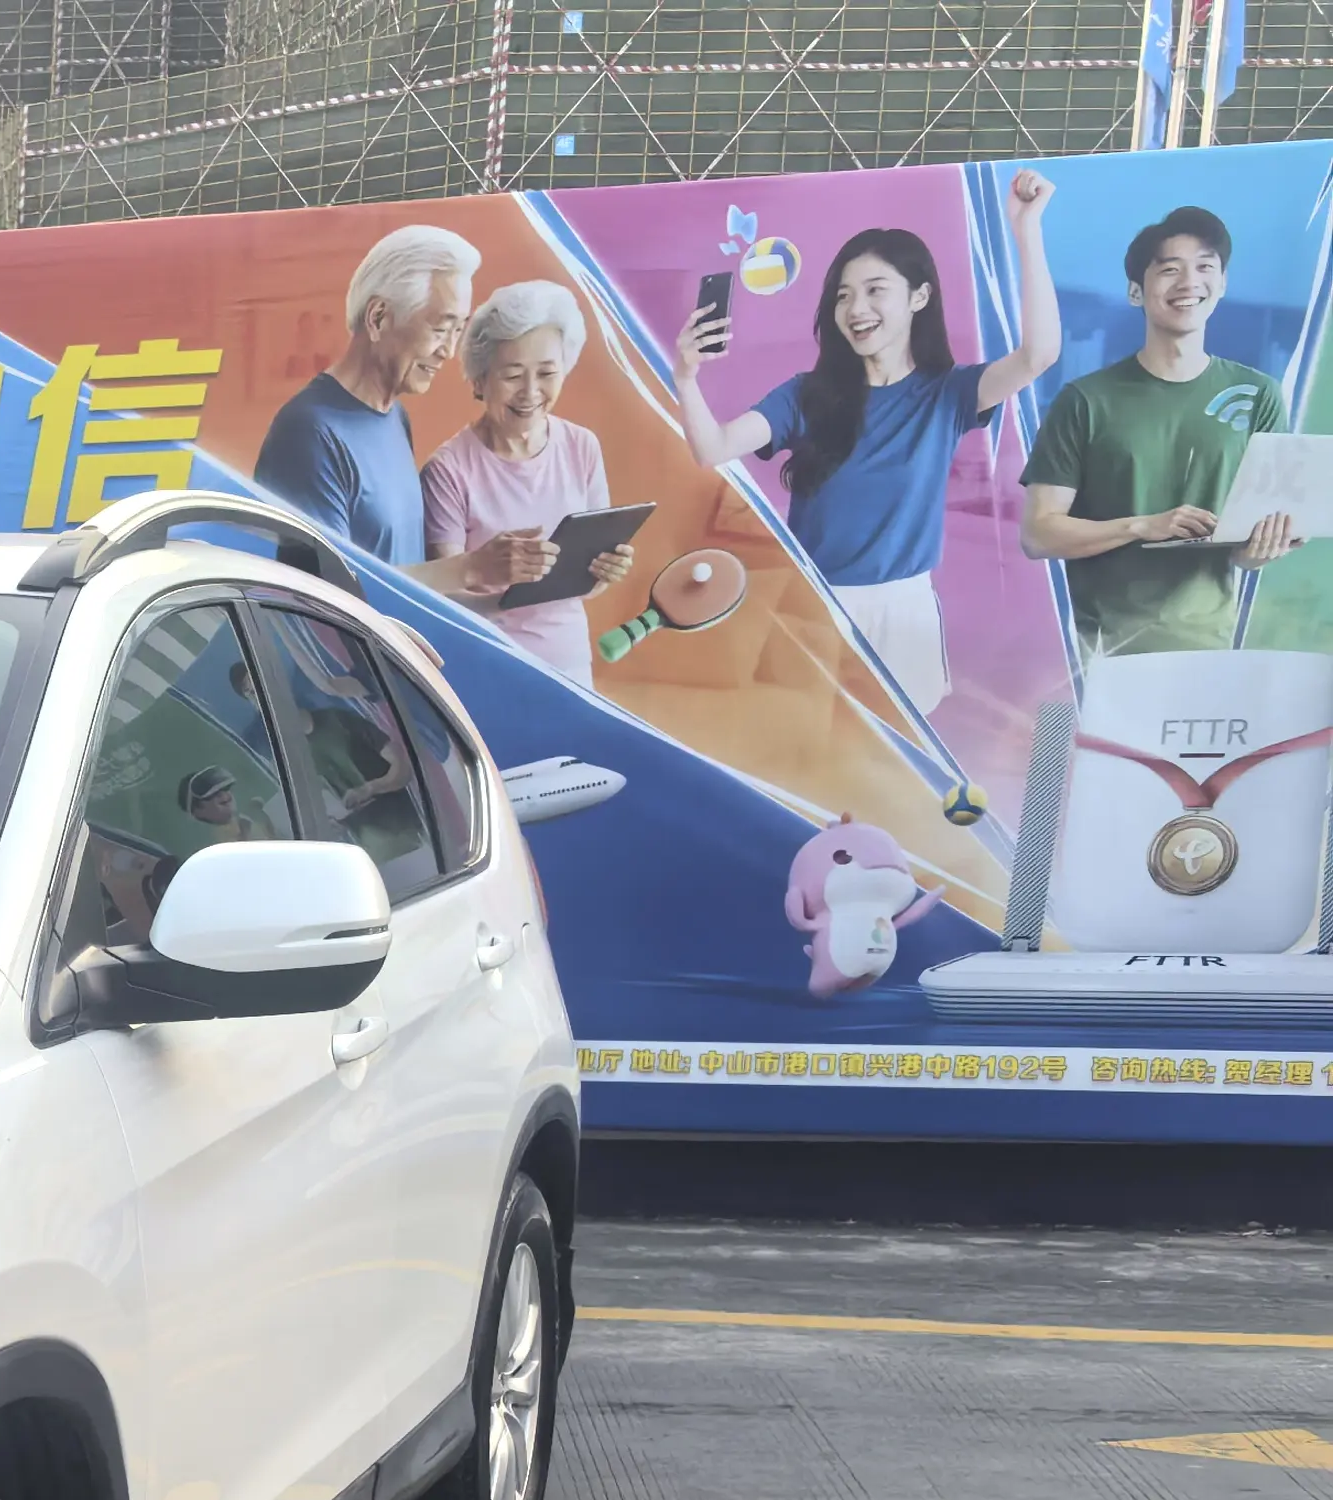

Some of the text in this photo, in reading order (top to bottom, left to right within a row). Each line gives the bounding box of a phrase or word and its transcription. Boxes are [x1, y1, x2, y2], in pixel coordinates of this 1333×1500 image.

[1160, 718, 1249, 746] FTTR
[1124, 955, 1227, 967] FTTR
[698, 1050, 1068, 1081] 中山市港口镇兴港中路192号
[1222, 1058, 1315, 1086] 贺经理
